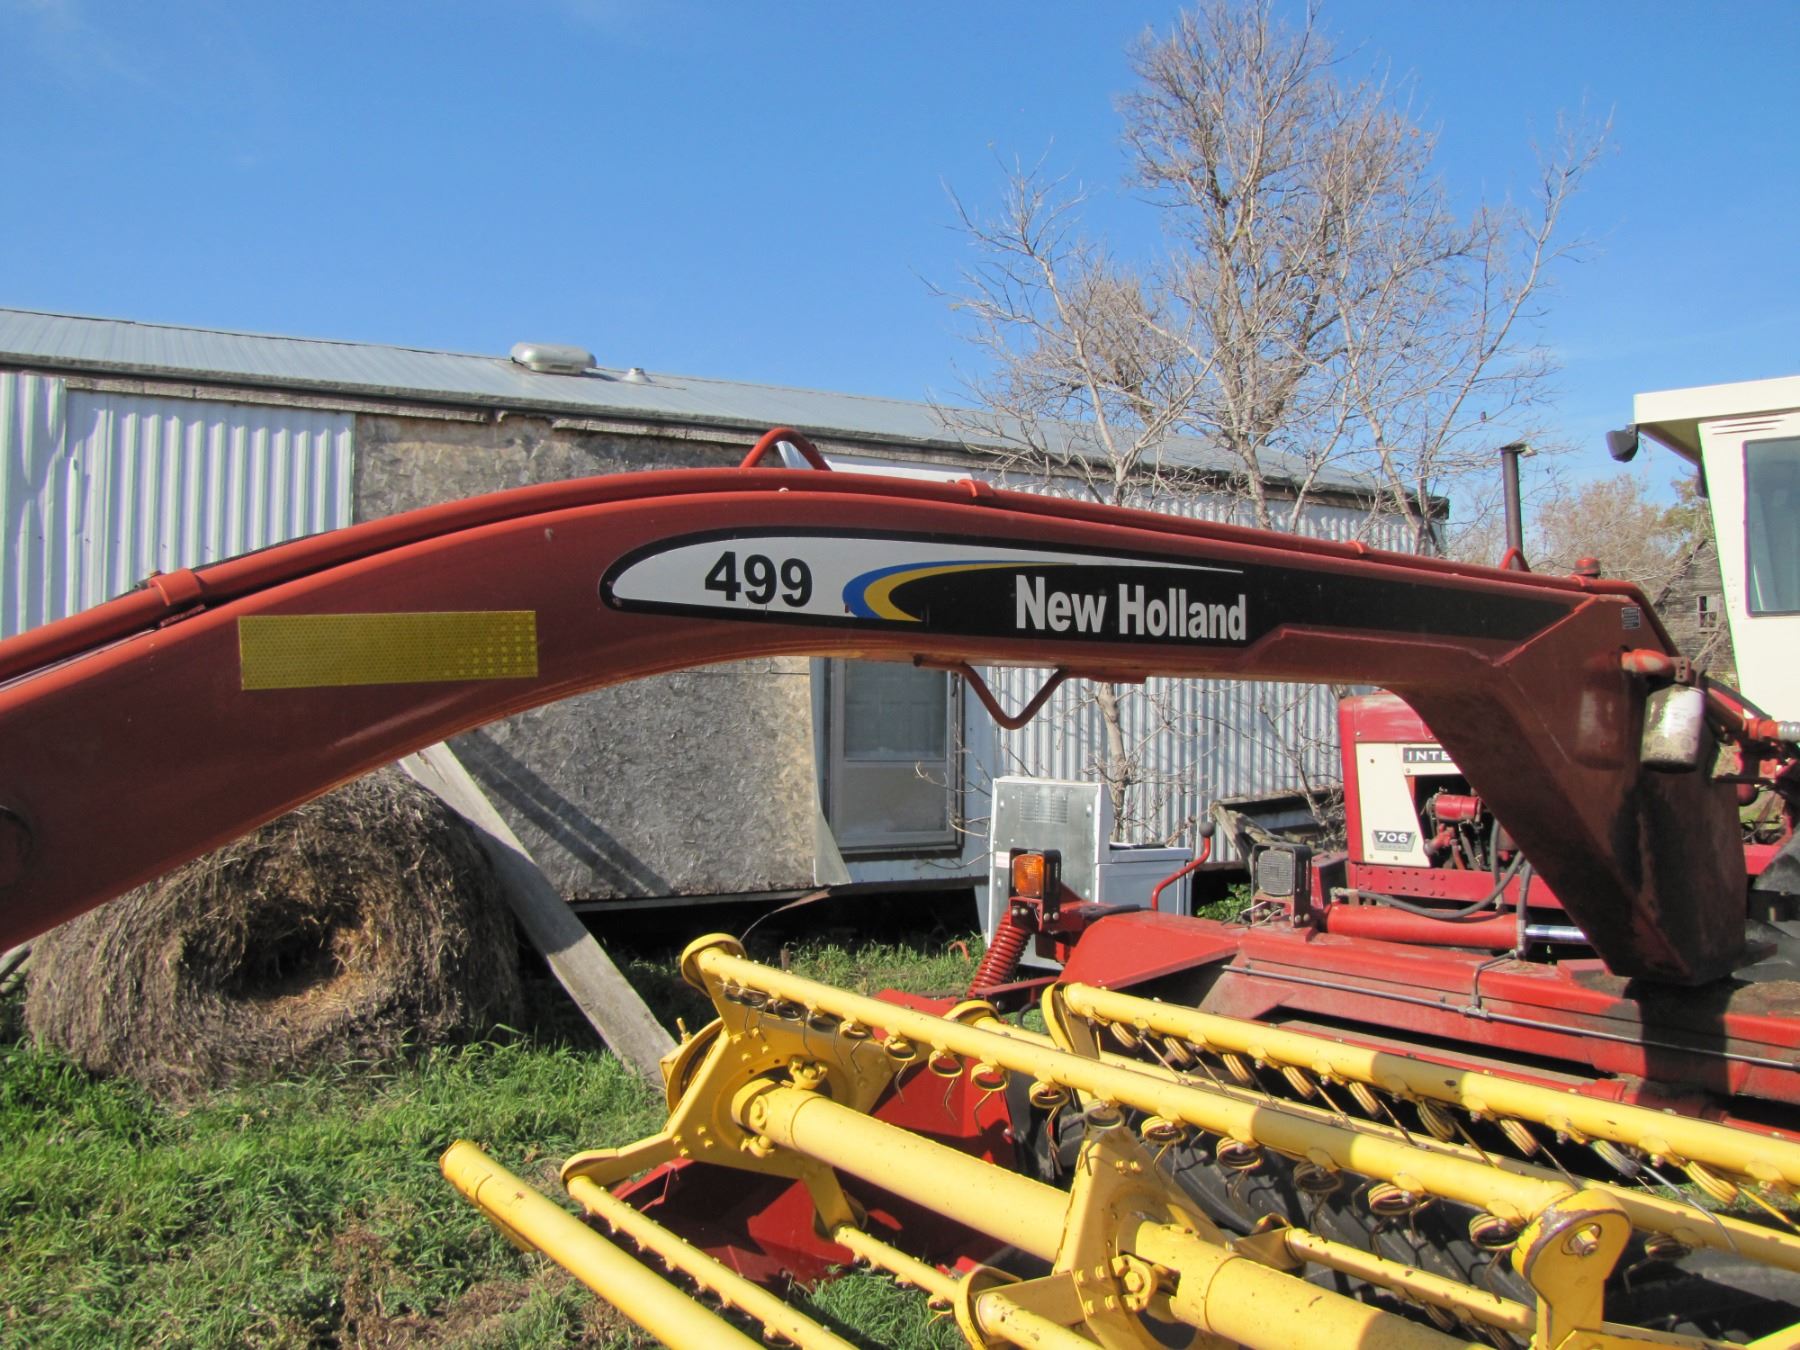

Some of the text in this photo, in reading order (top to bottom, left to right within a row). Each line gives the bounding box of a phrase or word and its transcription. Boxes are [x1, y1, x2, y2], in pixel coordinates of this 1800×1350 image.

[704, 551, 813, 608] 499
[1015, 574, 1247, 641] New Holland
[1378, 832, 1408, 842] 706
